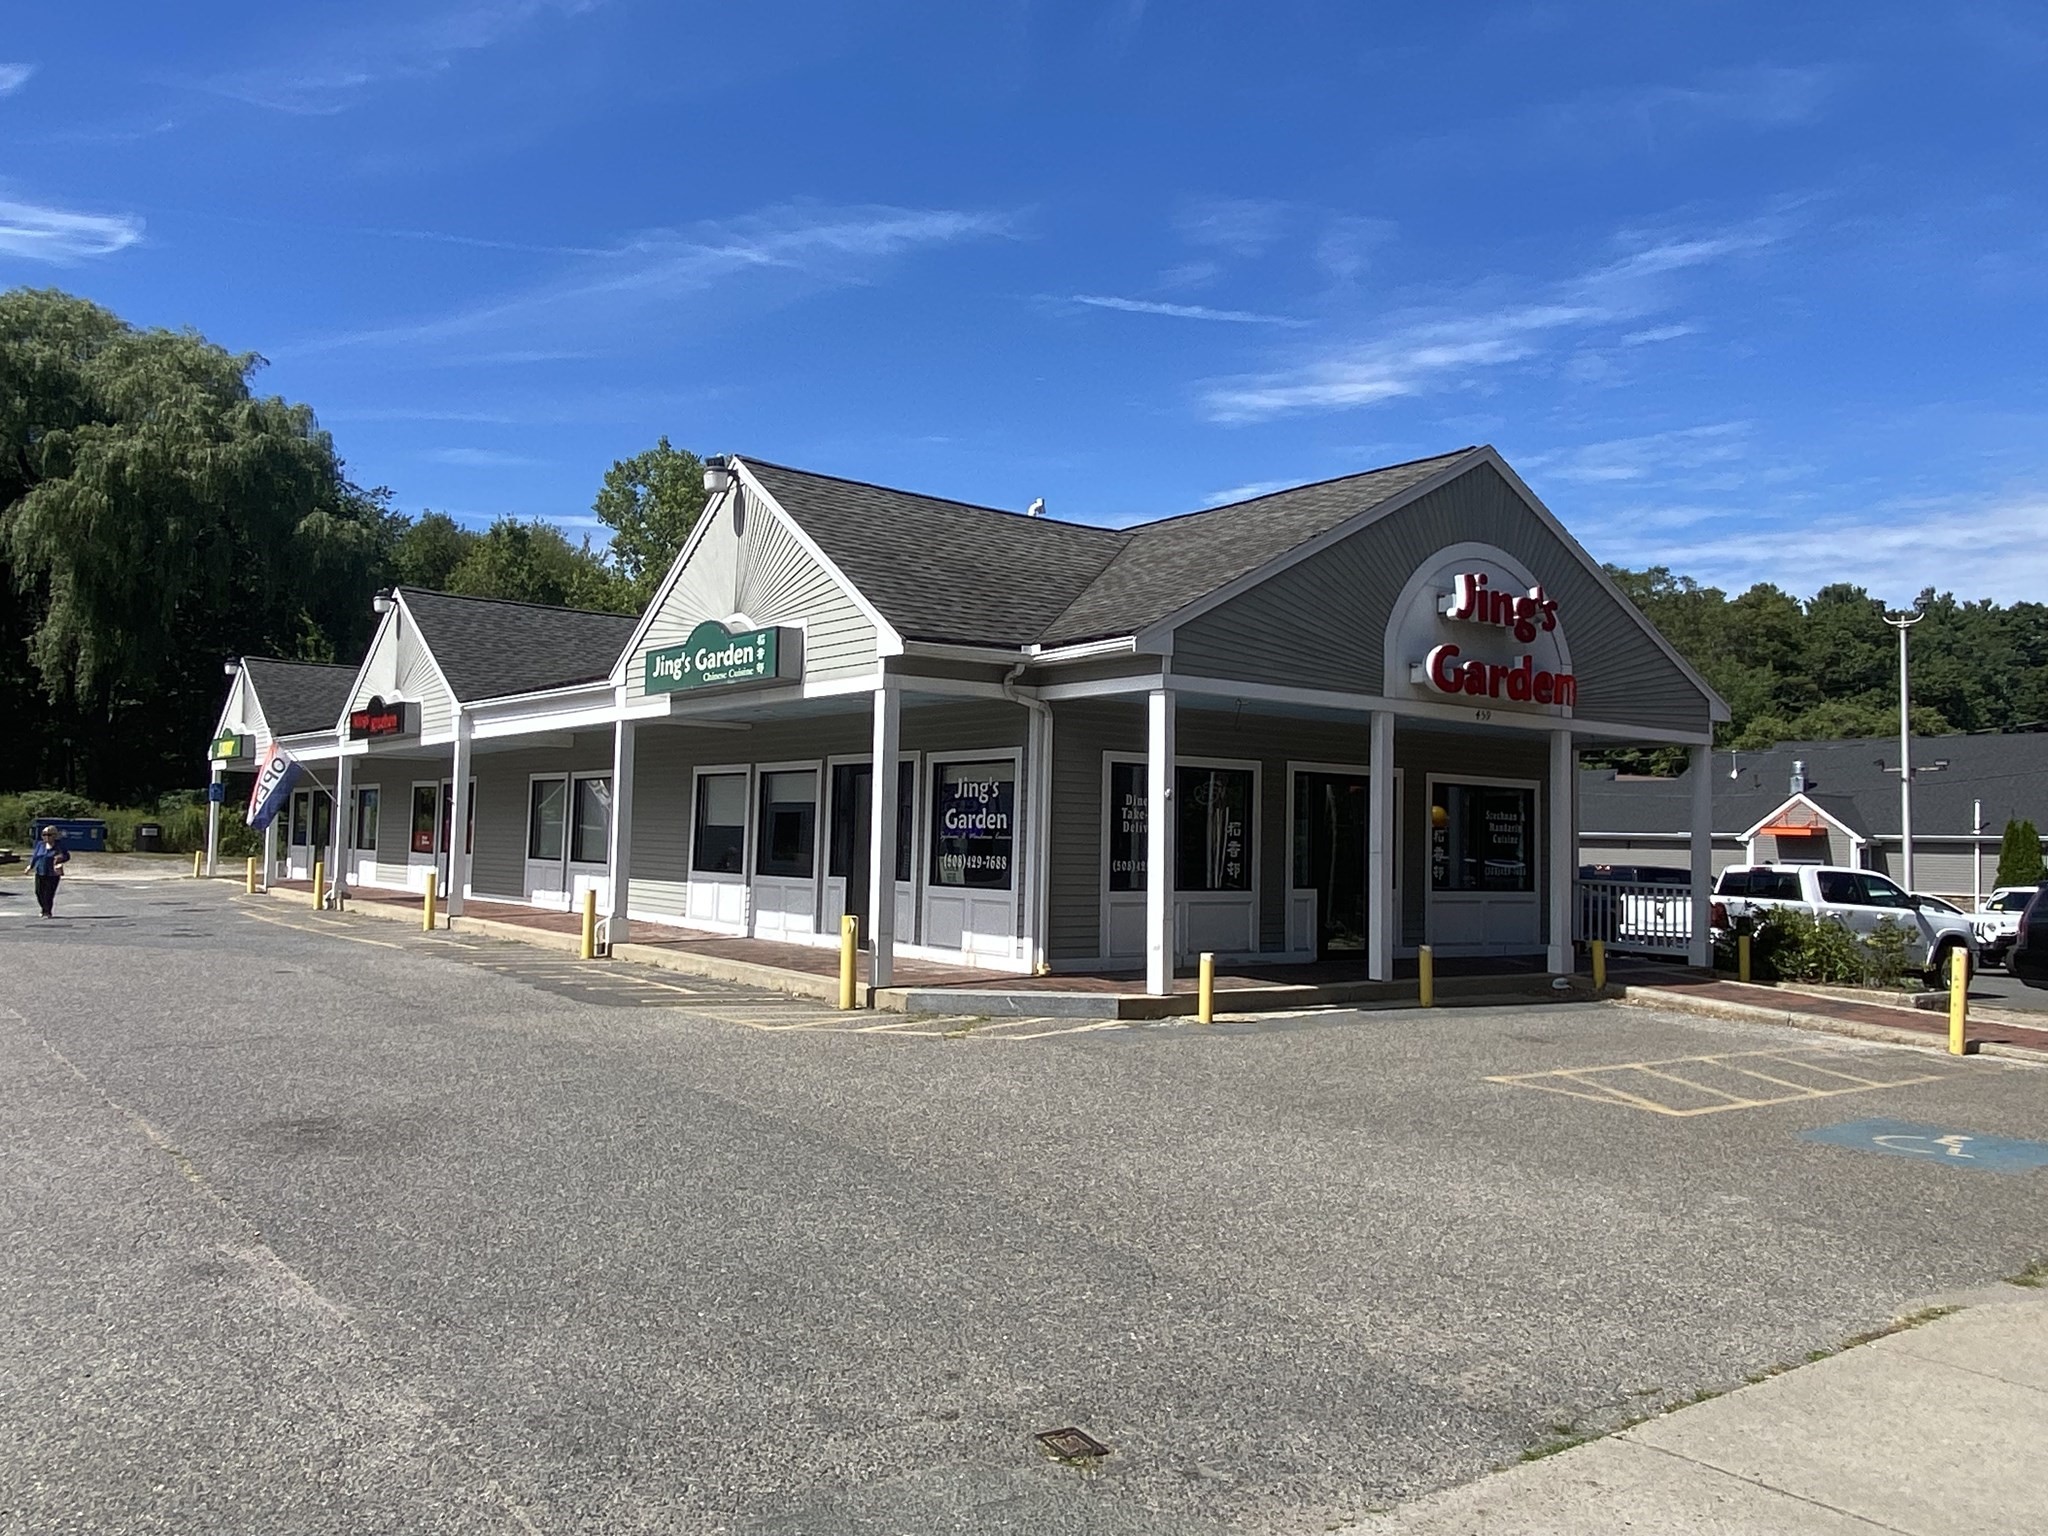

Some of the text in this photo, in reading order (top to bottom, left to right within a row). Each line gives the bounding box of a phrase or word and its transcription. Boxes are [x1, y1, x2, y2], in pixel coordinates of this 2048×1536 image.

[1454, 573, 1558, 643] Jing's
[652, 643, 754, 681] Jing's Garden
[702, 667, 754, 682] Chinese Cuisine
[1431, 644, 1577, 707] Garden
[954, 776, 1000, 804] Jing's
[944, 807, 1008, 830] Garden
[1121, 808, 1148, 820] Take-
[1122, 821, 1148, 833] Deliv
[1112, 859, 1147, 873] (508)42
